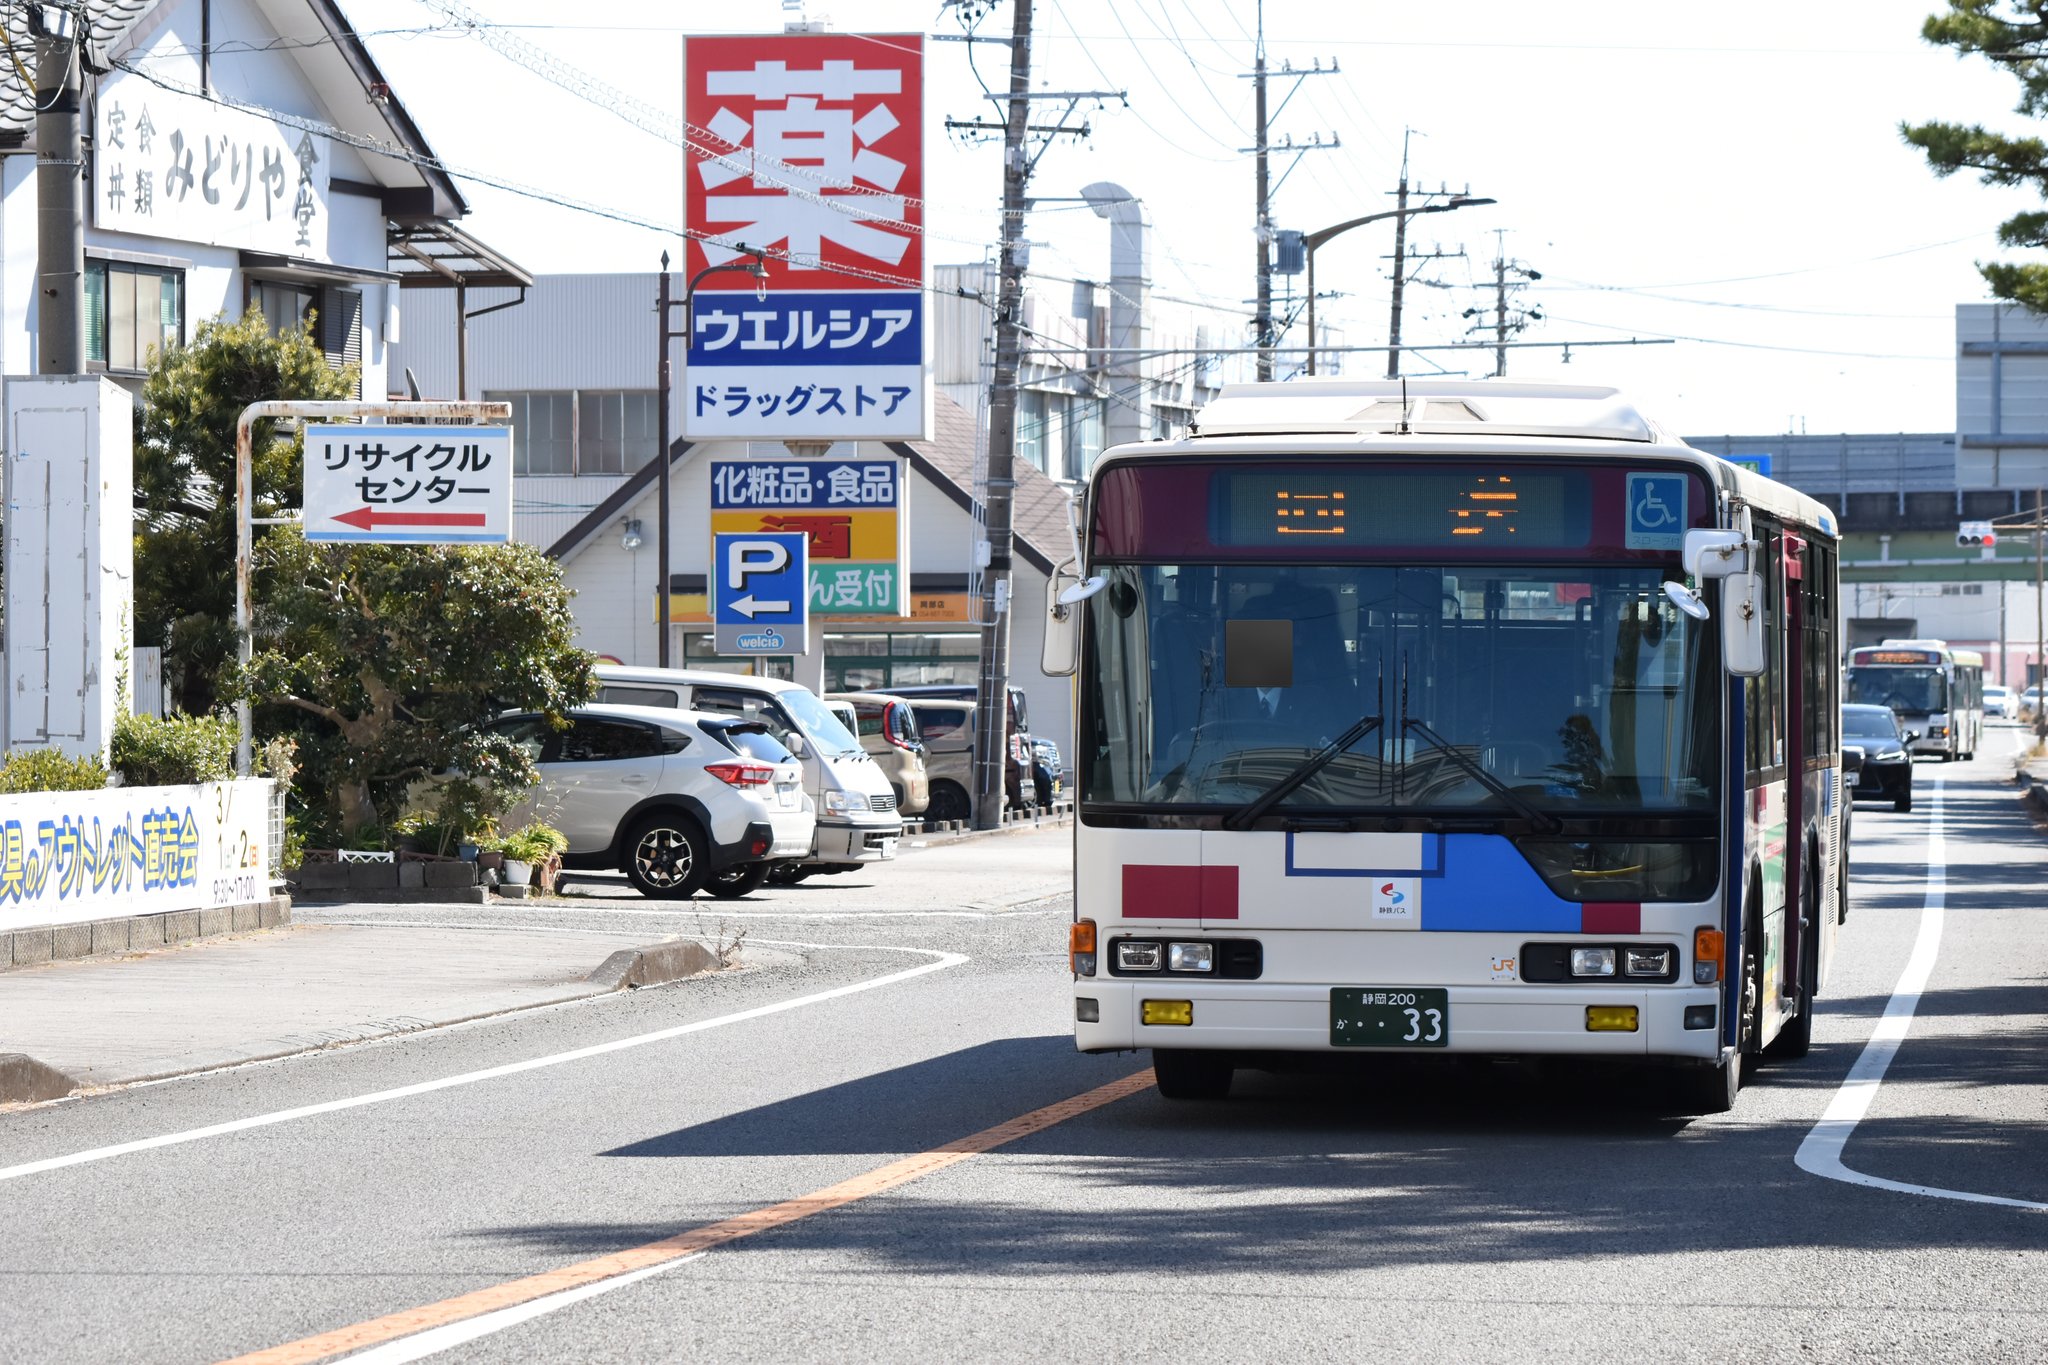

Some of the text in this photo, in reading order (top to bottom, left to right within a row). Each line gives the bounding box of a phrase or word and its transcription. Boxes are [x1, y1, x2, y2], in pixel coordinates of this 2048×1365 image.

[166, 128, 285, 221] みどりや
[697, 60, 911, 271] 薬
[293, 131, 320, 248] 食堂
[696, 309, 912, 351] ウエルシア
[696, 384, 911, 418] ドラッグストア
[325, 443, 492, 472] リサイクル
[355, 475, 490, 504] センター
[714, 465, 893, 504] 化粧品・食品
[728, 541, 790, 590] P
[740, 629, 779, 648] welcia
[0, 805, 199, 904] 具のアウトレット直売会
[1492, 959, 1515, 971] JR
